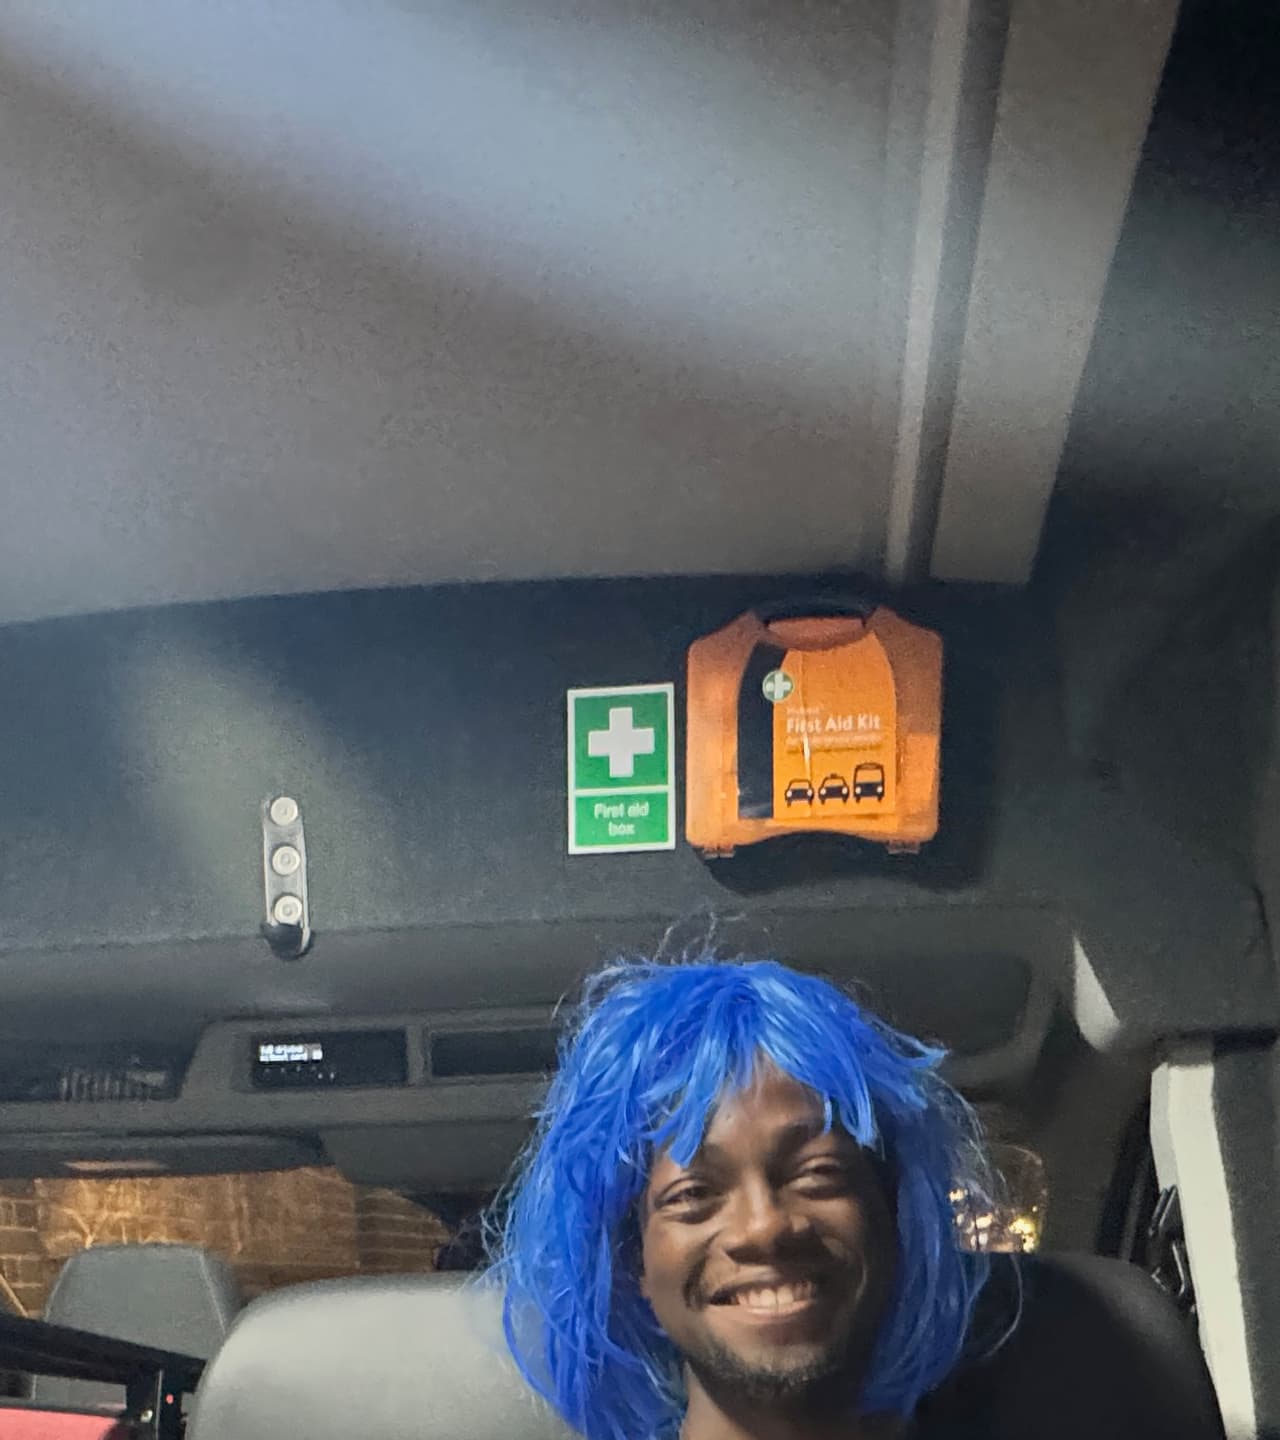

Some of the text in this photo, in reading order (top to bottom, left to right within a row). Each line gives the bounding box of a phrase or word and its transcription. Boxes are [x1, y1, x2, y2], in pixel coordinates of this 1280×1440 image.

[786, 713, 881, 734] First Aid Kit
[593, 801, 649, 819] First aid
[608, 821, 635, 836] box
